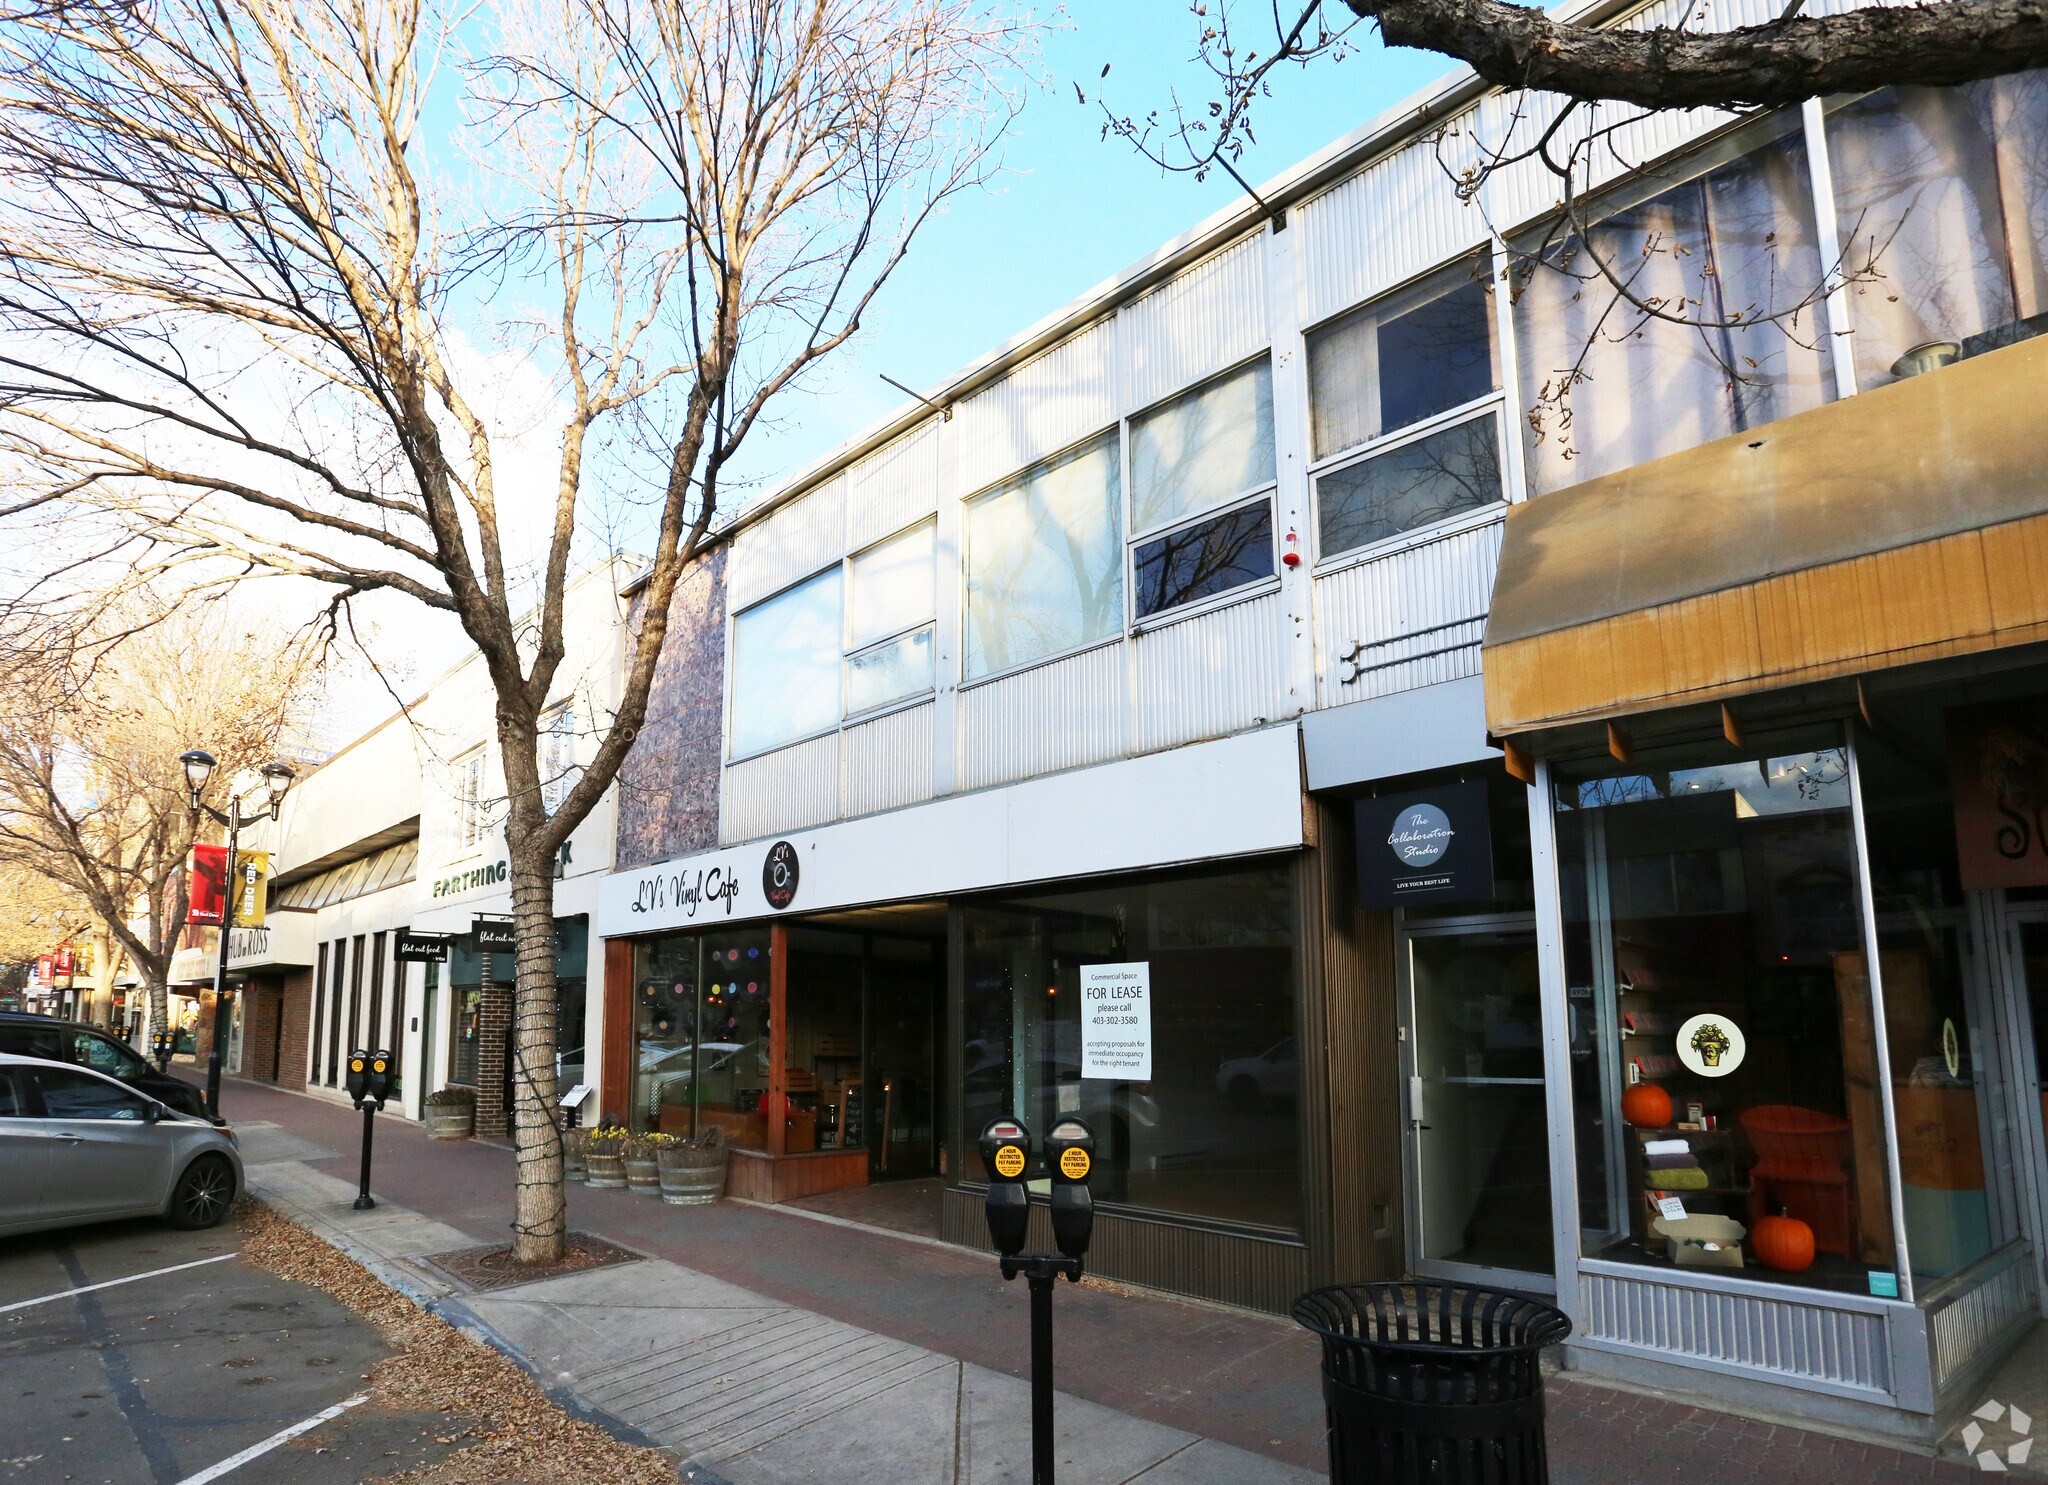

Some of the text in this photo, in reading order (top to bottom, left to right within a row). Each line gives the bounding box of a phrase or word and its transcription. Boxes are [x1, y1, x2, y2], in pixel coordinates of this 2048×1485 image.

[1411, 814, 1429, 826] The
[1388, 828, 1455, 845] Collaboration
[1404, 844, 1438, 858] Studio
[433, 860, 507, 898] FARTHING
[244, 862, 256, 916] RED DEER
[631, 866, 739, 917] LV's Vinyl Cafe
[480, 930, 495, 943] flat
[495, 932, 508, 942] out
[227, 933, 242, 959] HUB
[247, 928, 268, 956] ROSS
[401, 943, 441, 954] flat out food
[1091, 972, 1138, 981] Commercial Space
[1087, 986, 1143, 999] FOR LEASE
[1097, 1003, 1132, 1013] please call
[1092, 1016, 1138, 1025] 403-302-3580
[1086, 1040, 1145, 1049] accepting proposals for
[1115, 1050, 1144, 1058] occupancy
[1109, 1059, 1122, 1068] right
